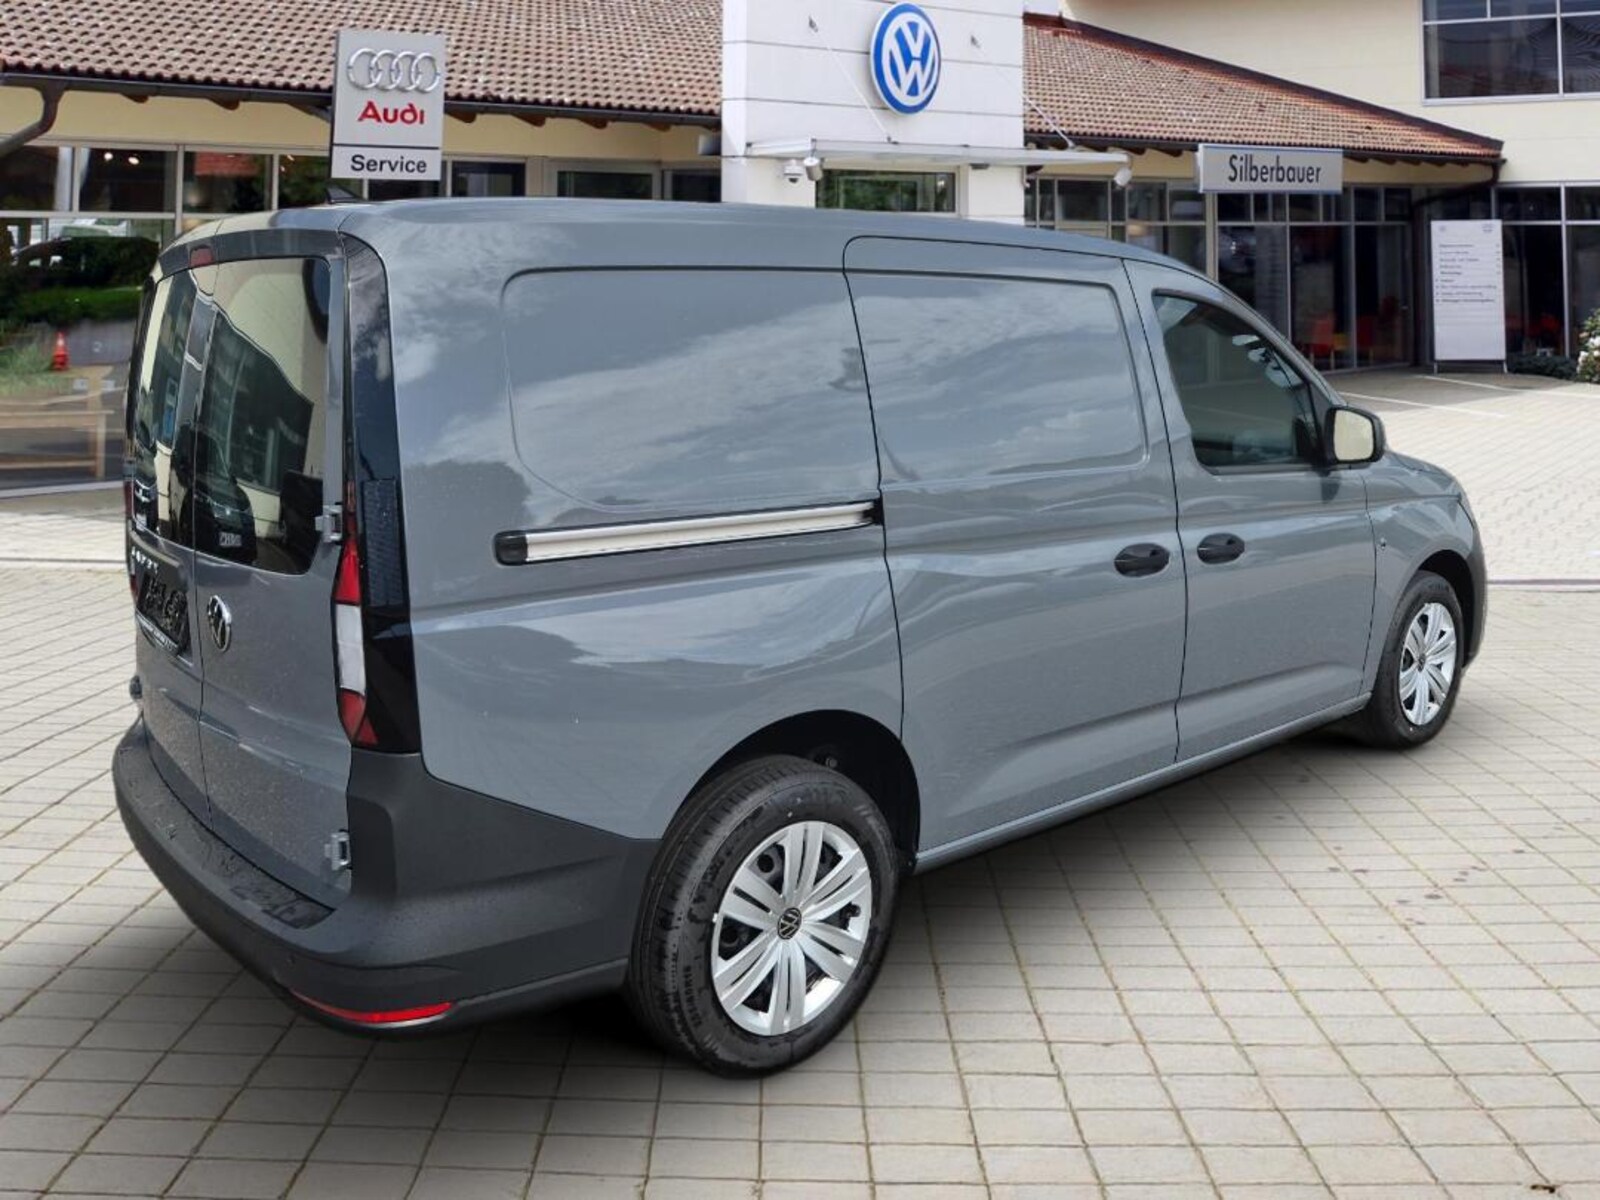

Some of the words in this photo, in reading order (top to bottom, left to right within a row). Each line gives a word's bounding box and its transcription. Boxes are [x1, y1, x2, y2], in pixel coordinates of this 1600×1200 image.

[358, 101, 424, 124] Audi
[351, 154, 427, 173] Service
[1228, 153, 1321, 183] Silberbauer
